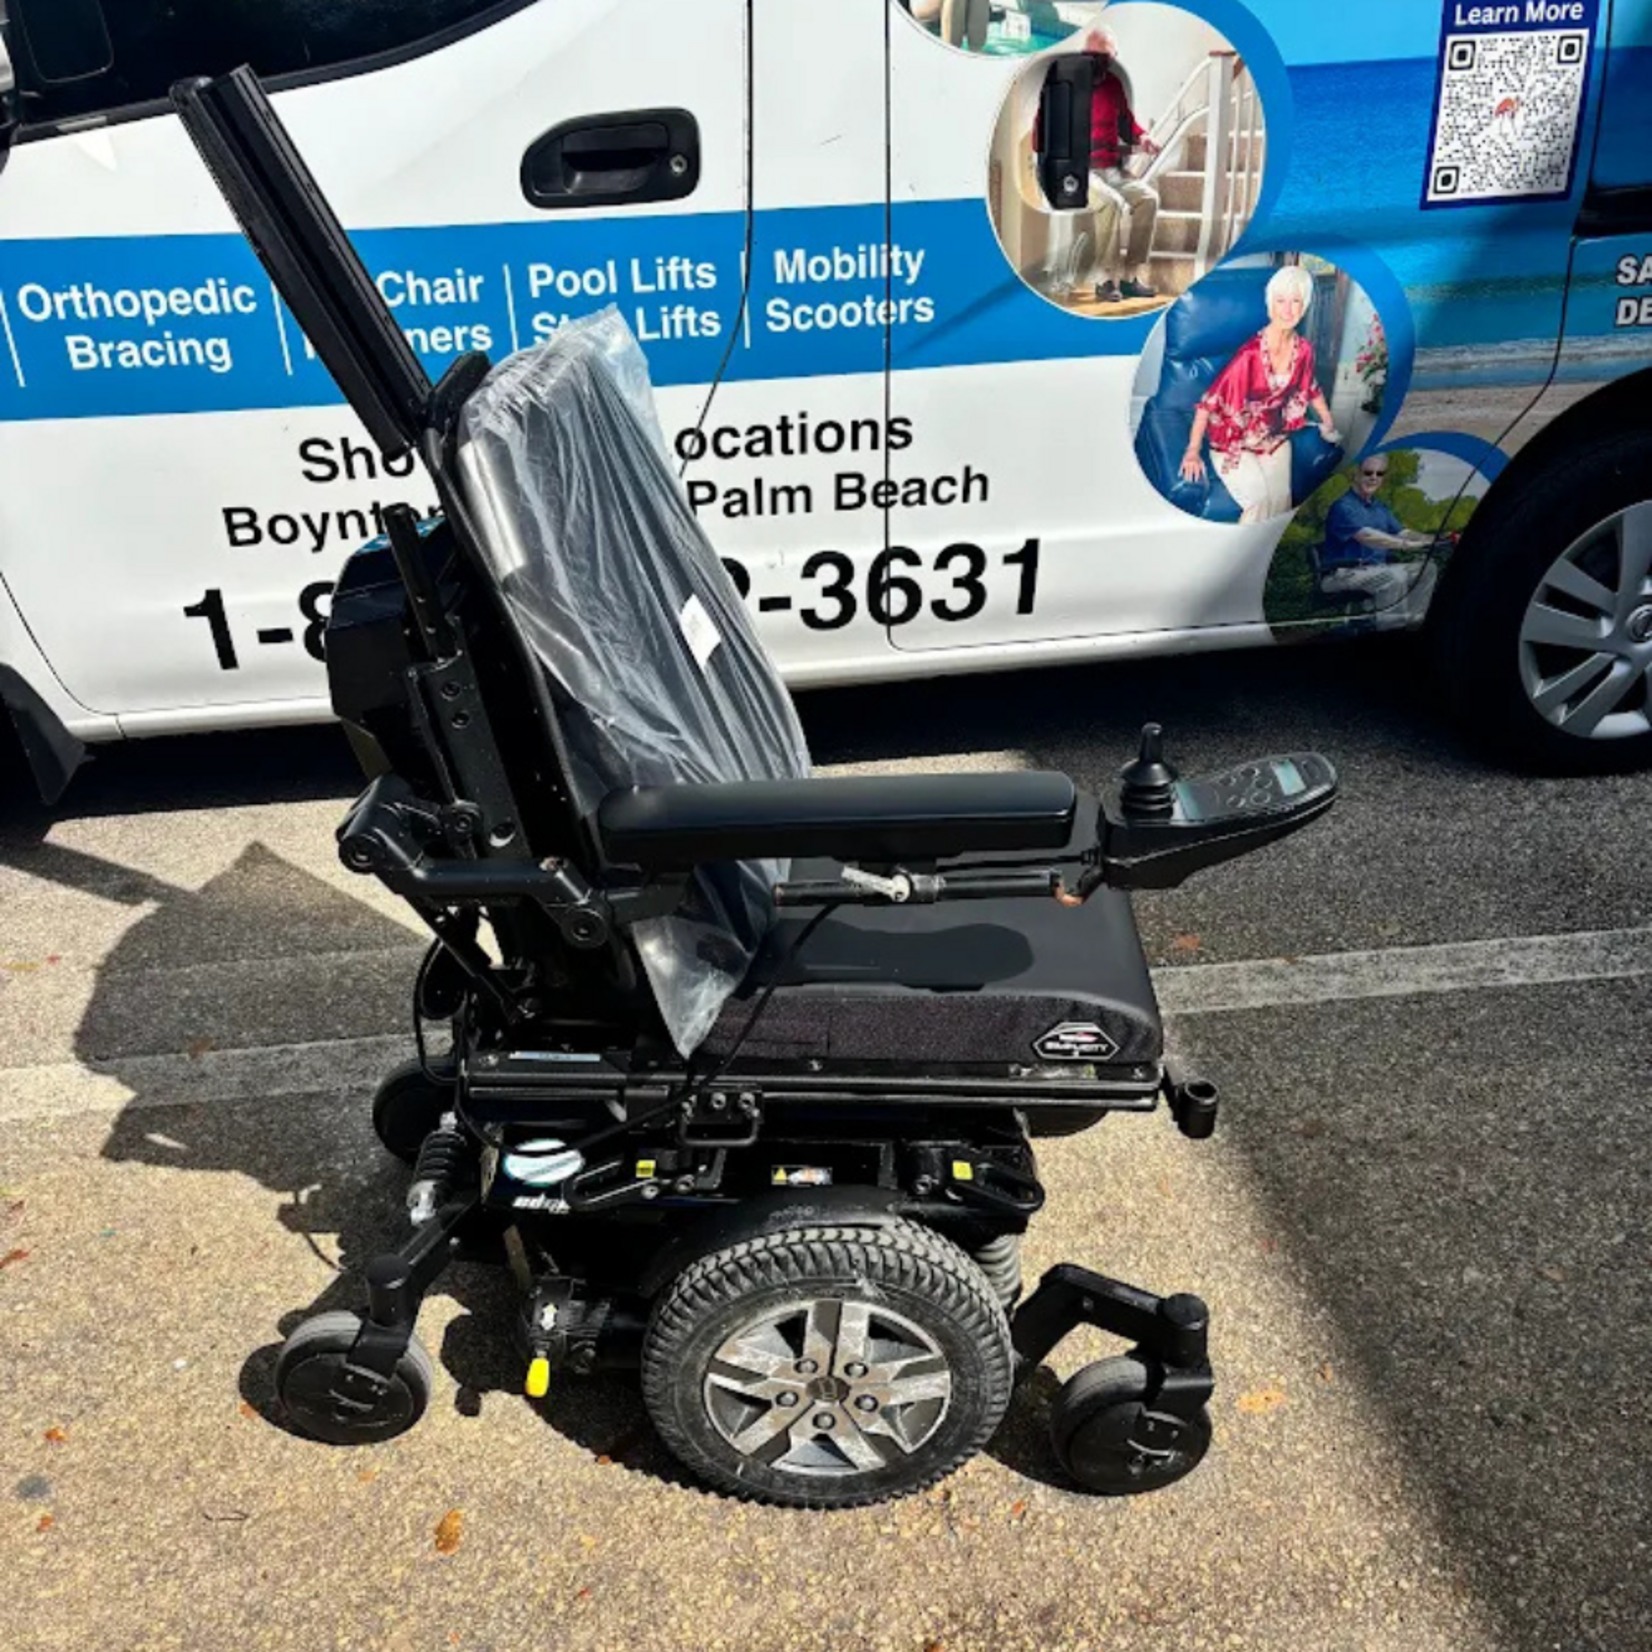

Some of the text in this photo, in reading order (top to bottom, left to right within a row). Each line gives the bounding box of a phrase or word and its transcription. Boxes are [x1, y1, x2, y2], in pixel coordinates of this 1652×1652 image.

[1454, 0, 1584, 26] Learn More
[527, 256, 718, 299] Pool Lifts
[773, 244, 926, 285] Mobility
[17, 277, 258, 325] Orthopedic
[374, 267, 485, 307] Chair
[636, 305, 722, 341] Lifts
[765, 295, 936, 333] Scooters
[65, 330, 234, 374] Bracing
[299, 410, 915, 482] Sho ocations
[222, 465, 989, 554] Boynt Palm Beach
[183, 580, 333, 670] 1-8
